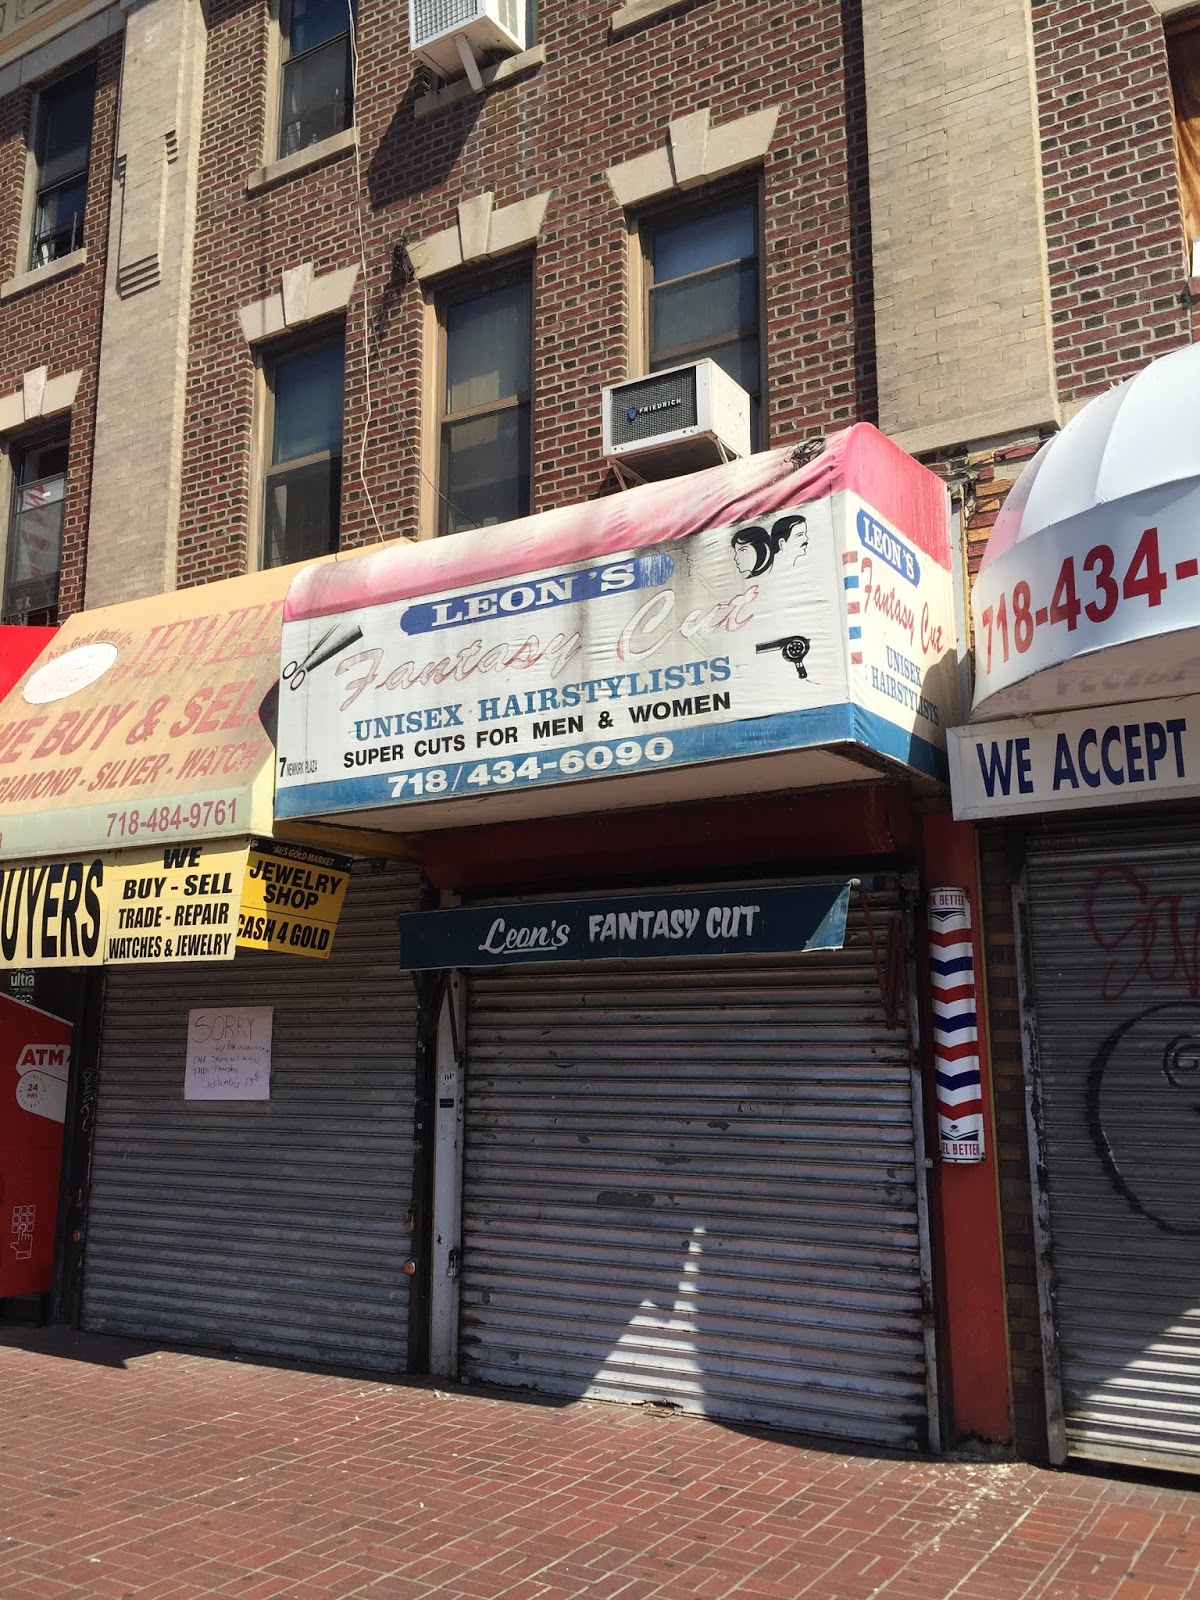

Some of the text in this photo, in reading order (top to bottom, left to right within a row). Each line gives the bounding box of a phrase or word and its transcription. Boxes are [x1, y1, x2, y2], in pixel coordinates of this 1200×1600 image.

[639, 398, 682, 414] FRIEDRICH
[863, 516, 915, 580] LEON'S
[860, 556, 916, 647] Fantasy
[334, 584, 760, 712] Fantasy Cut
[885, 645, 922, 688] UNISEX
[354, 656, 732, 742] UNISEX HAIRSTYLISTS
[871, 664, 940, 727] HAIRSTYLISTS
[31, 700, 141, 760] BUY
[126, 694, 171, 745] &
[343, 691, 731, 769] SUPER CUTS FOR MEN & WOMEN
[87, 753, 171, 793] SILVER
[279, 756, 287, 778] 7
[975, 717, 1187, 798] WE ACCEPT
[106, 797, 238, 838] 718-484-9761
[163, 846, 203, 870] WE
[288, 848, 308, 860] GOLD
[306, 853, 335, 867] MARKET
[122, 876, 167, 900] BUY
[183, 872, 233, 897] SELL
[249, 859, 343, 896] JEWELRY
[263, 883, 320, 910] SHOP
[0, 857, 104, 962] UYERS
[118, 906, 163, 930] TRADE
[173, 902, 230, 926] REPAIR
[108, 933, 232, 960] WATCHES & JEWELRY
[236, 913, 330, 951] CASH 4 GOLD
[478, 905, 760, 955] Leon's FANTASY CUT
[10, 971, 35, 987] ultra
[192, 1014, 255, 1044] SORRY
[21, 1048, 64, 1066] ATM
[27, 1083, 39, 1092] 24
